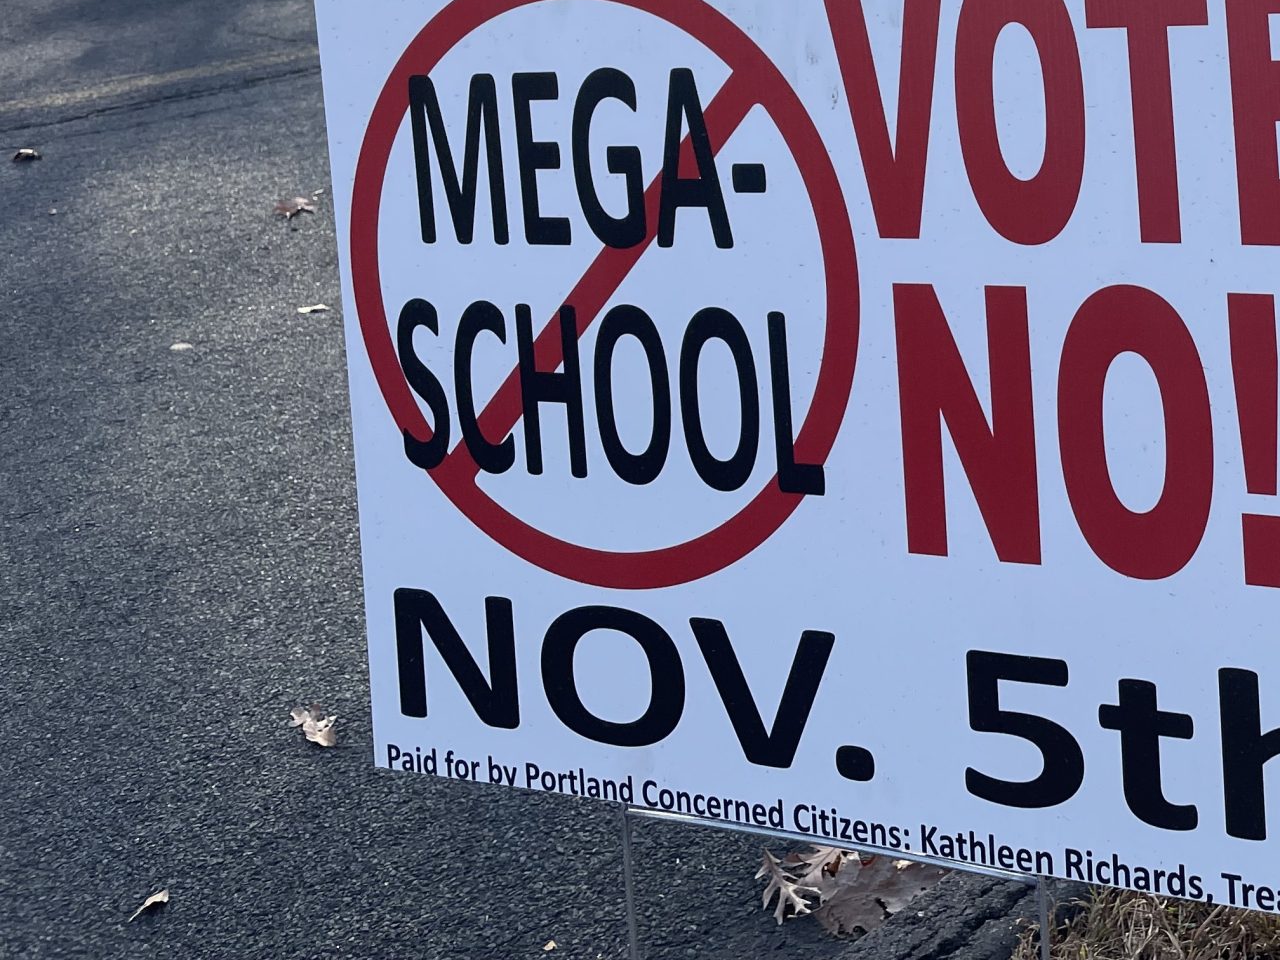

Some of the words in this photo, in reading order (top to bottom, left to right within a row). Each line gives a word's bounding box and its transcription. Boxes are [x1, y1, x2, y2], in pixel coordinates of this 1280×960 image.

[408, 66, 767, 251] MEGA-
[397, 297, 826, 496] SCHOOL
[393, 586, 875, 782] NOV.
[386, 744, 438, 776] Paid
[445, 750, 480, 781] for
[488, 756, 516, 787] by
[526, 762, 634, 804] Portland
[642, 780, 784, 830] Concerned
[793, 804, 911, 852] Citizens:
[920, 825, 1054, 875] Kathleen
[1065, 848, 1214, 904] Richards,
